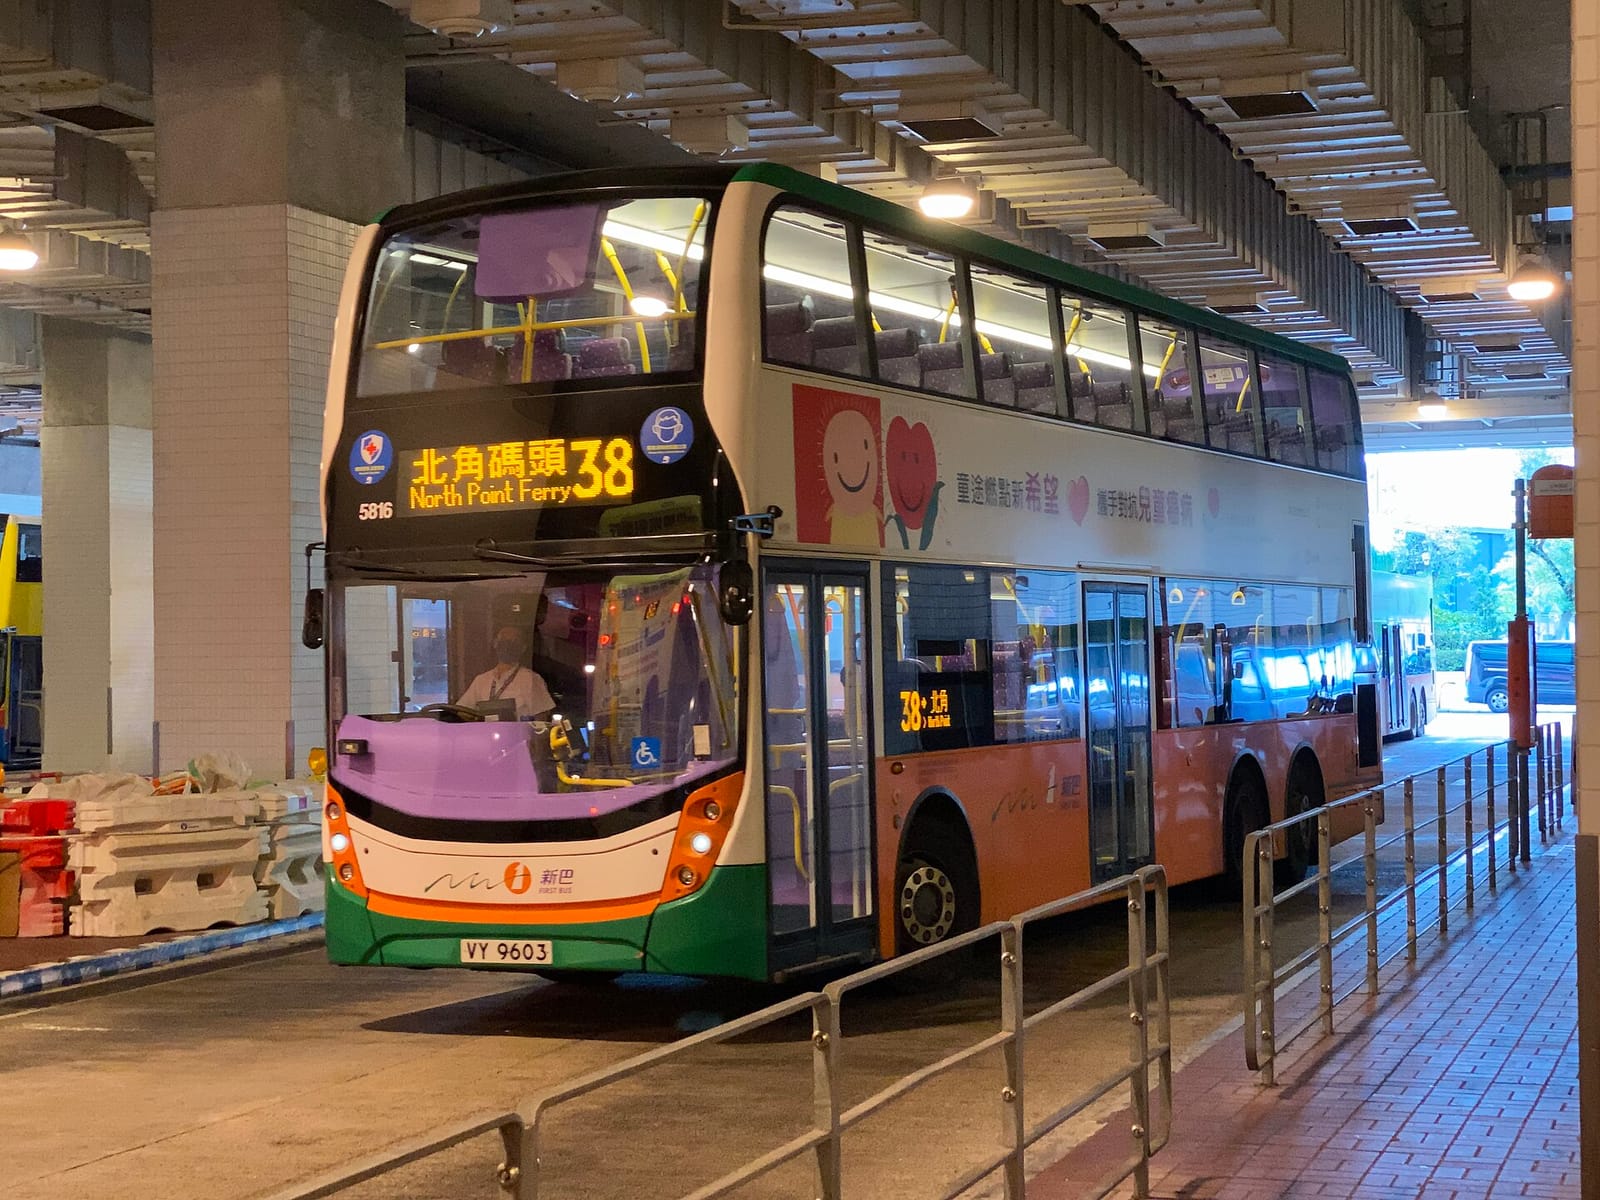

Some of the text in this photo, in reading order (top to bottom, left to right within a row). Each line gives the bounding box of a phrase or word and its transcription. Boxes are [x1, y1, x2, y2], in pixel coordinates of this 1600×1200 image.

[411, 439, 568, 485] 北角碼頭
[570, 438, 634, 498] 38
[409, 478, 572, 509] North Point Ferry
[358, 501, 394, 521] 5816
[900, 690, 922, 732] 38
[930, 689, 948, 714] 北角
[539, 868, 574, 885] 新巴
[466, 942, 547, 961] VY 9603
